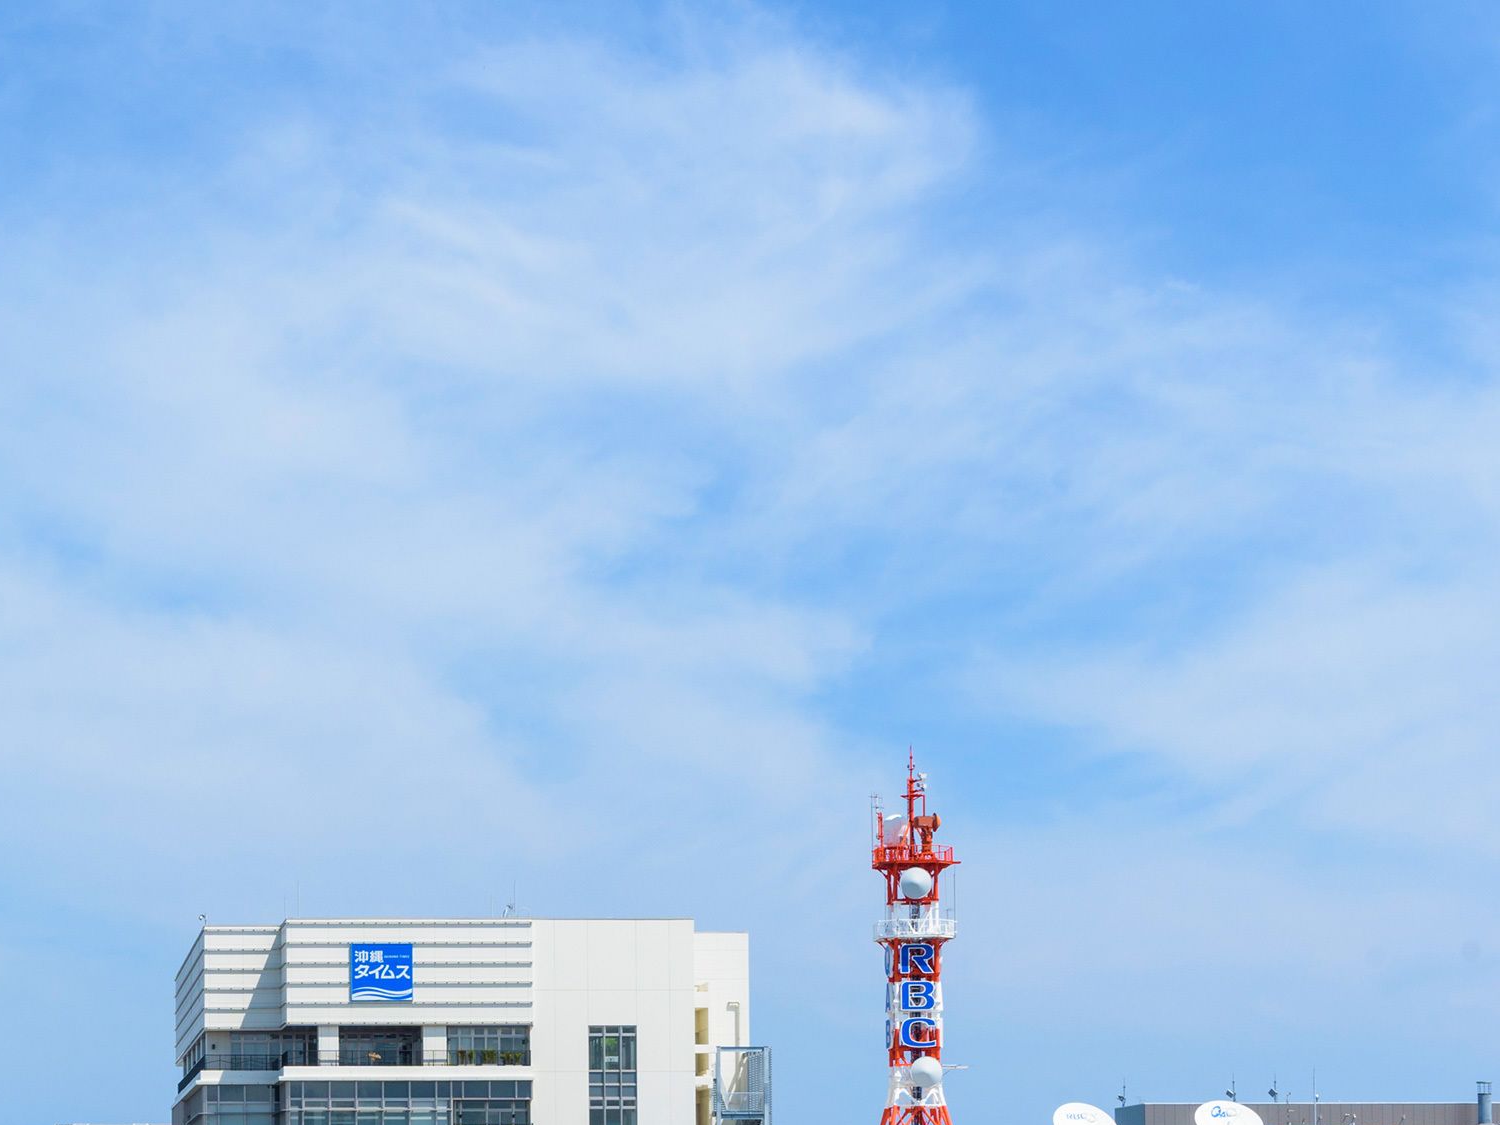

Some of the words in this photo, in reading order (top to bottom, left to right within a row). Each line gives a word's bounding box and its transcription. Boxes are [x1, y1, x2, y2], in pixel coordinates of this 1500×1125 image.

[354, 950, 384, 963] 沖縄
[354, 964, 411, 979] タイムス
[900, 943, 937, 1048] RBC
